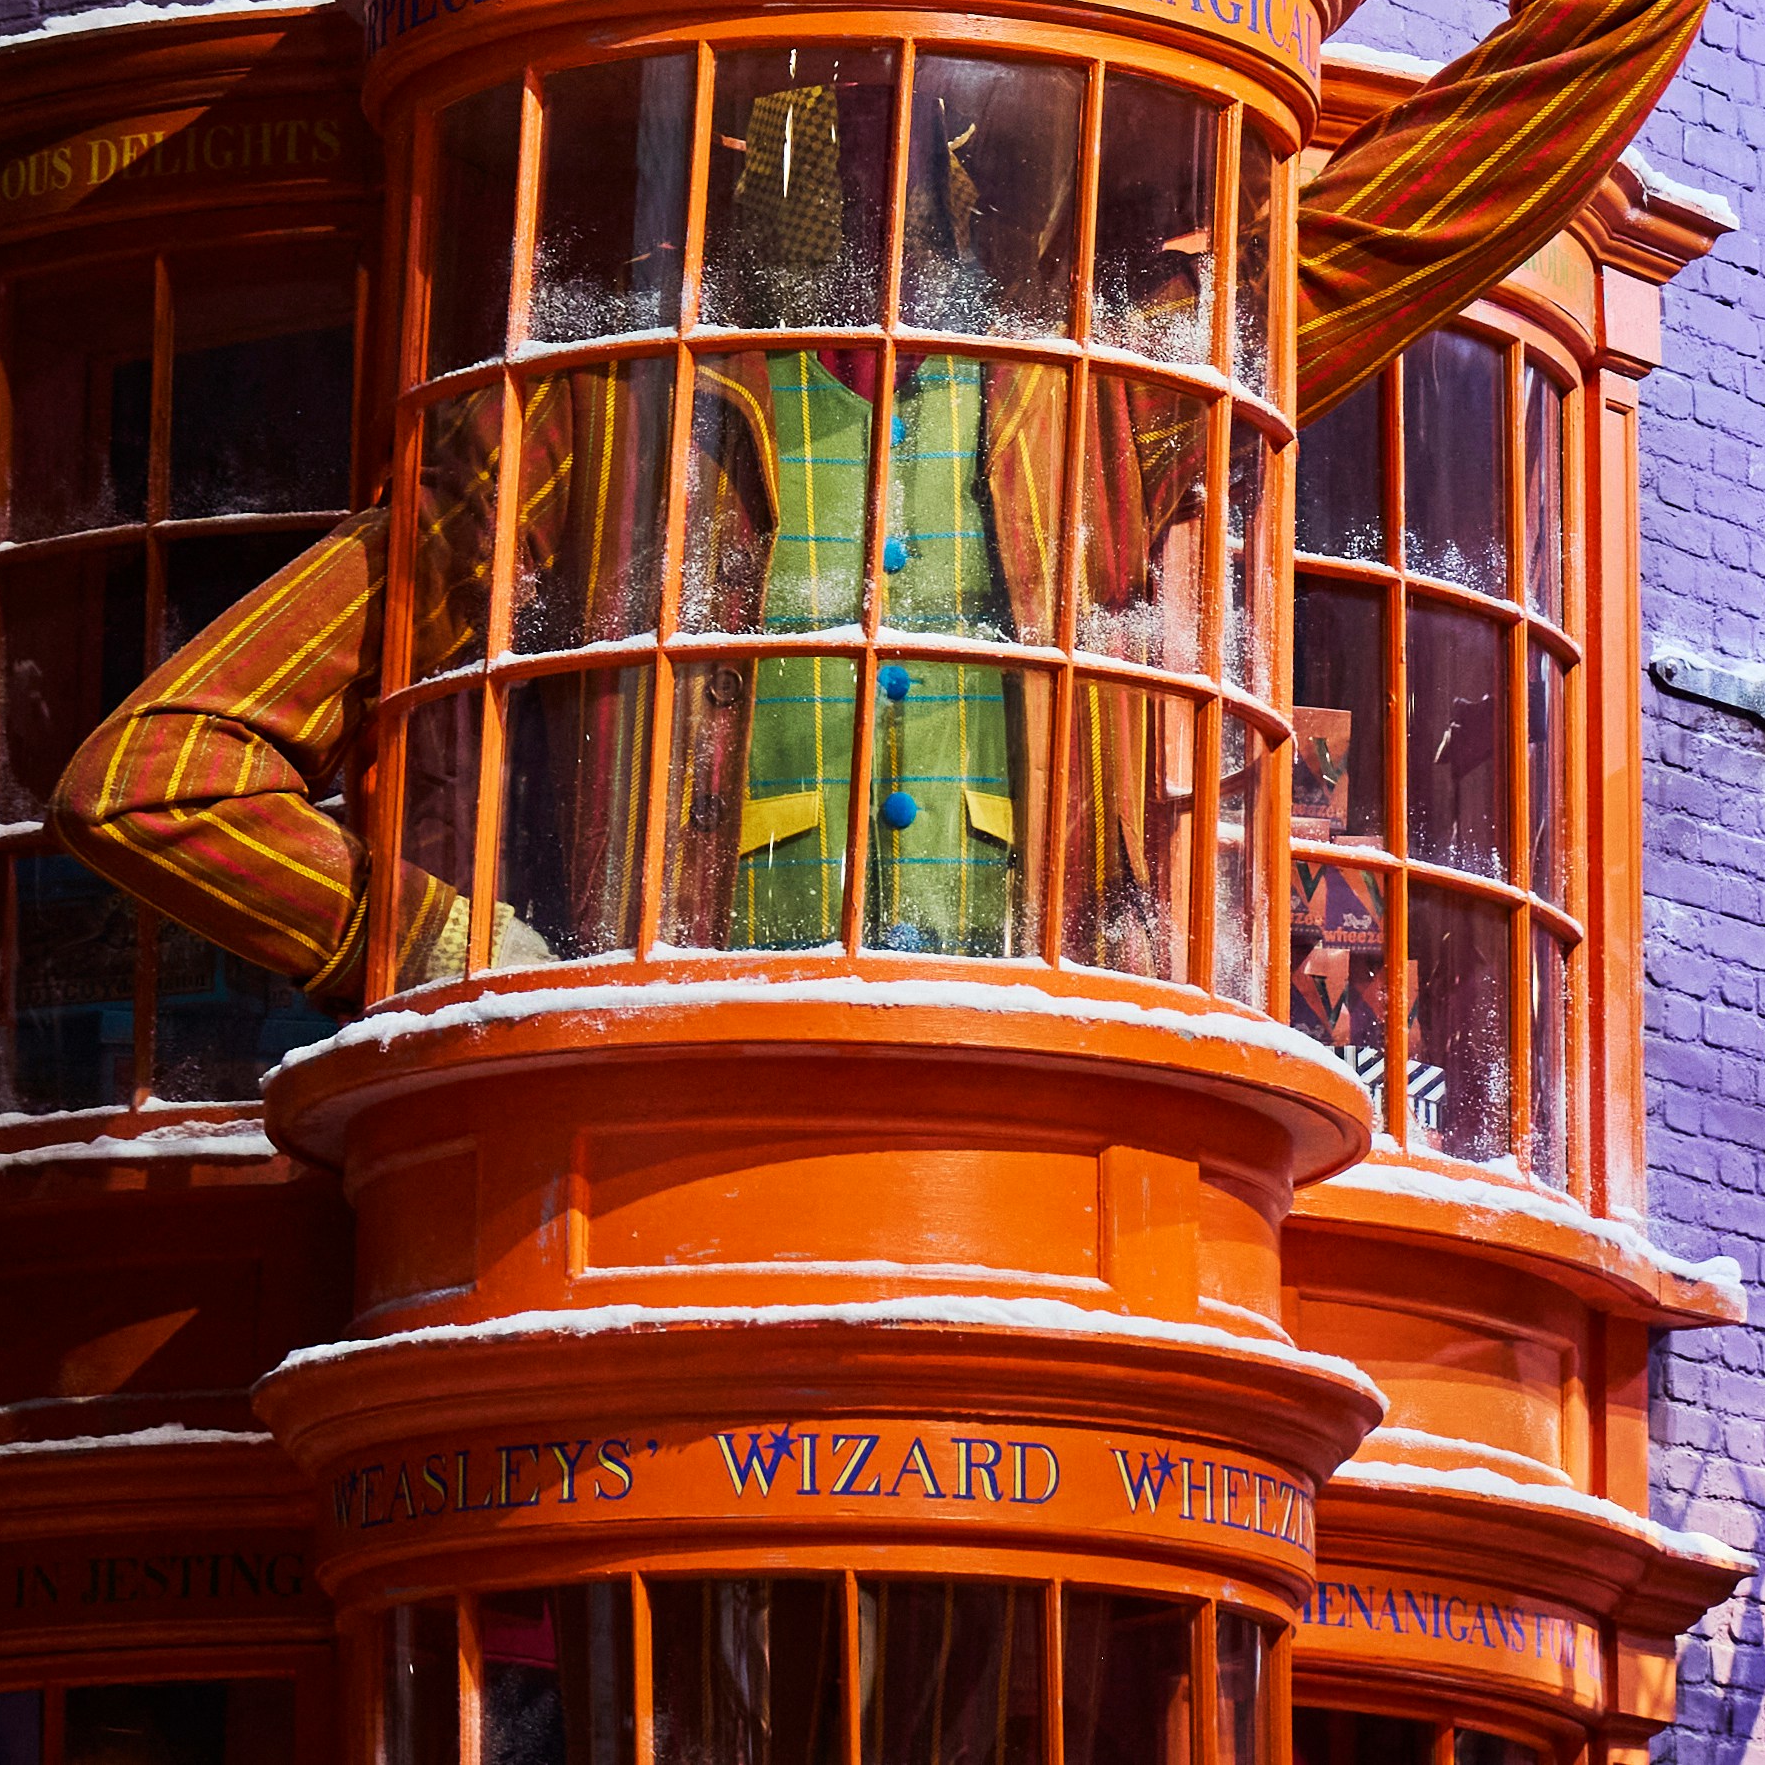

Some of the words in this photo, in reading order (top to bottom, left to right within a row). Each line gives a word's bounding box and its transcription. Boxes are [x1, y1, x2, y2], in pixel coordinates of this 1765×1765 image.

[86, 118, 342, 186] DELIGHTS
[334, 1437, 659, 1531] WEASLEYS'
[716, 1424, 1061, 1506] WIZARD
[81, 1551, 304, 1604] JESTING
